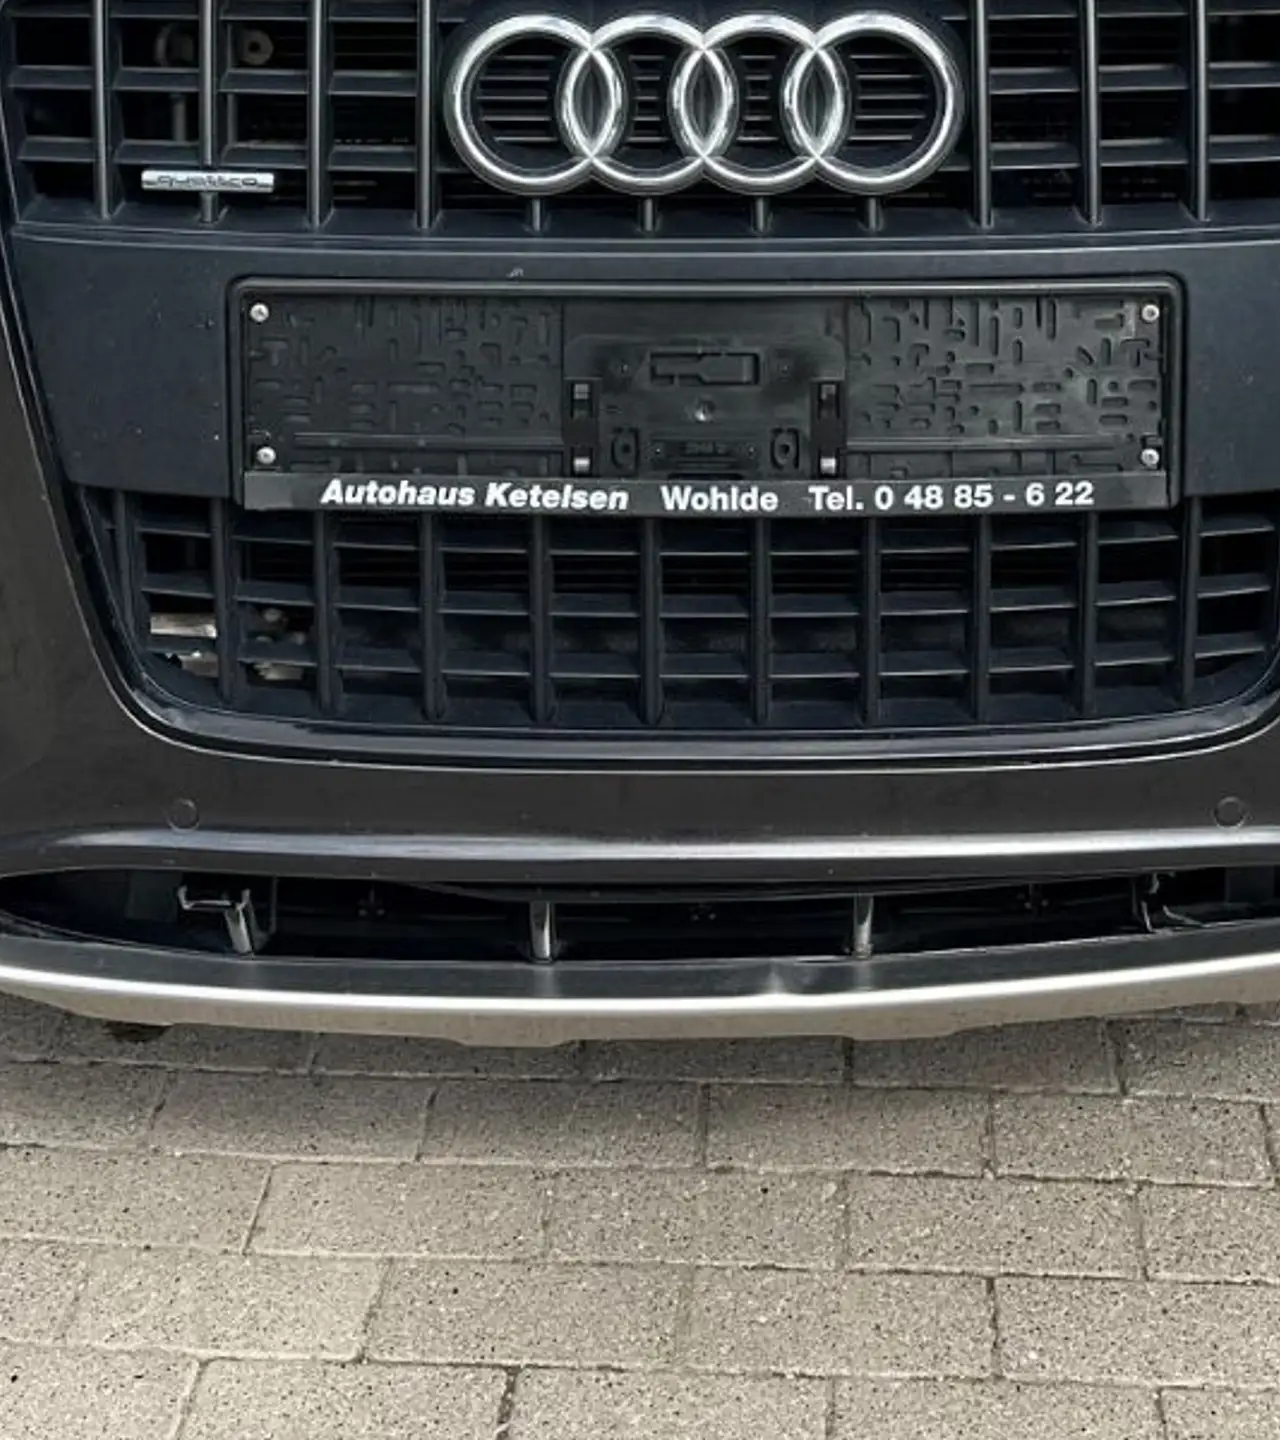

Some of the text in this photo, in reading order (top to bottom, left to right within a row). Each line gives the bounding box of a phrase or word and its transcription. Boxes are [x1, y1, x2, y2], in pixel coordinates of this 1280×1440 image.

[320, 478, 476, 507] Autohaus
[484, 482, 630, 510] Ketelsen
[660, 485, 780, 512] Wohlde
[807, 485, 865, 511] Tel.
[874, 485, 895, 511] 0
[903, 484, 945, 510] 48
[953, 482, 994, 509] 85
[1025, 482, 1046, 507] 6
[1055, 481, 1095, 506] 22
